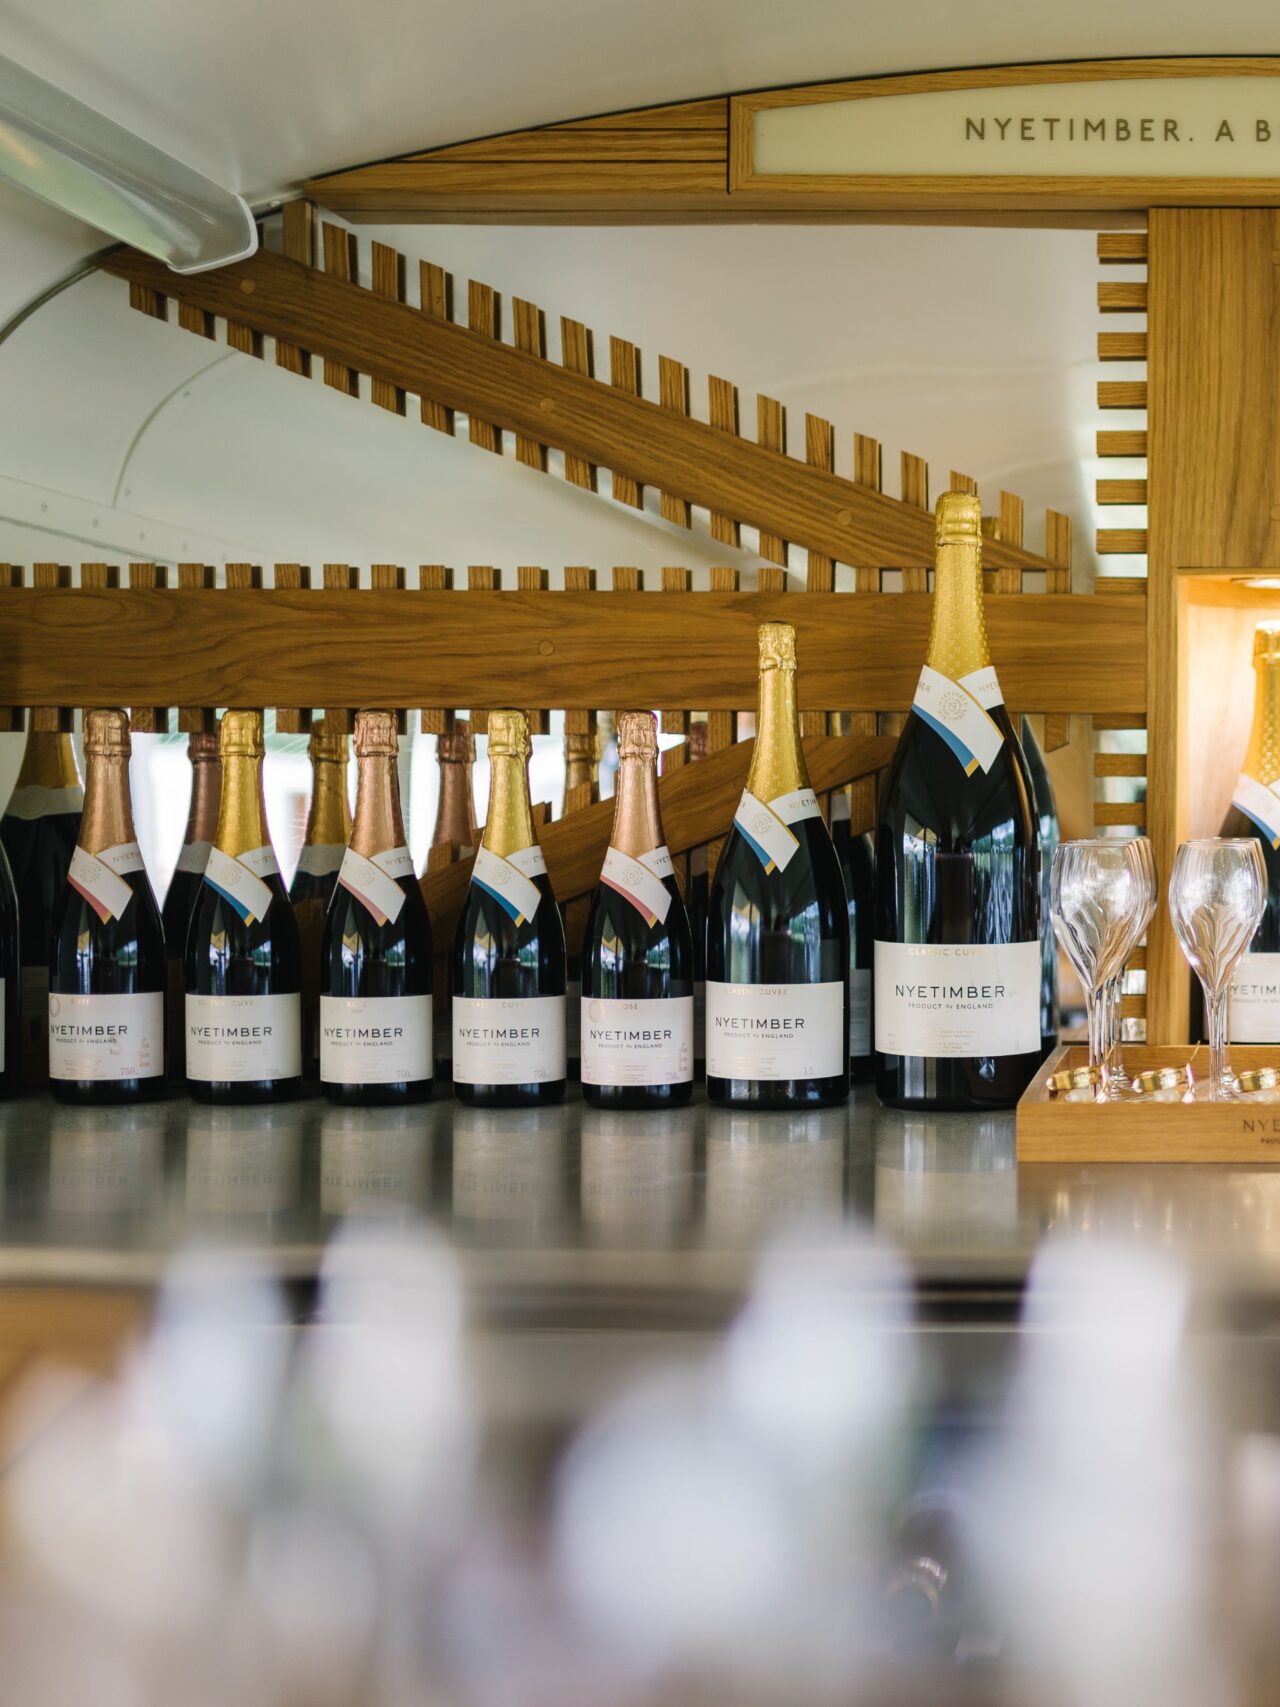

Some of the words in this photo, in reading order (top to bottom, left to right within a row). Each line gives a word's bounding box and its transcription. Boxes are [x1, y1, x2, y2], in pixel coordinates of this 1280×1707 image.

[965, 117, 1194, 141] NYETIMBER.
[1214, 119, 1235, 142] A
[895, 984, 1006, 999] NYETIMBER
[908, 1002, 943, 1010] PRODUCT
[956, 1002, 994, 1010] ENGLAND
[715, 1016, 805, 1030] NYETIMBER
[50, 1025, 128, 1036] NYETIMBER
[190, 1026, 273, 1038] NYETIMBER
[323, 1027, 404, 1039] NYETIMBER
[459, 1028, 541, 1039] NYETIMBER
[590, 1029, 672, 1041] NYETIMBER
